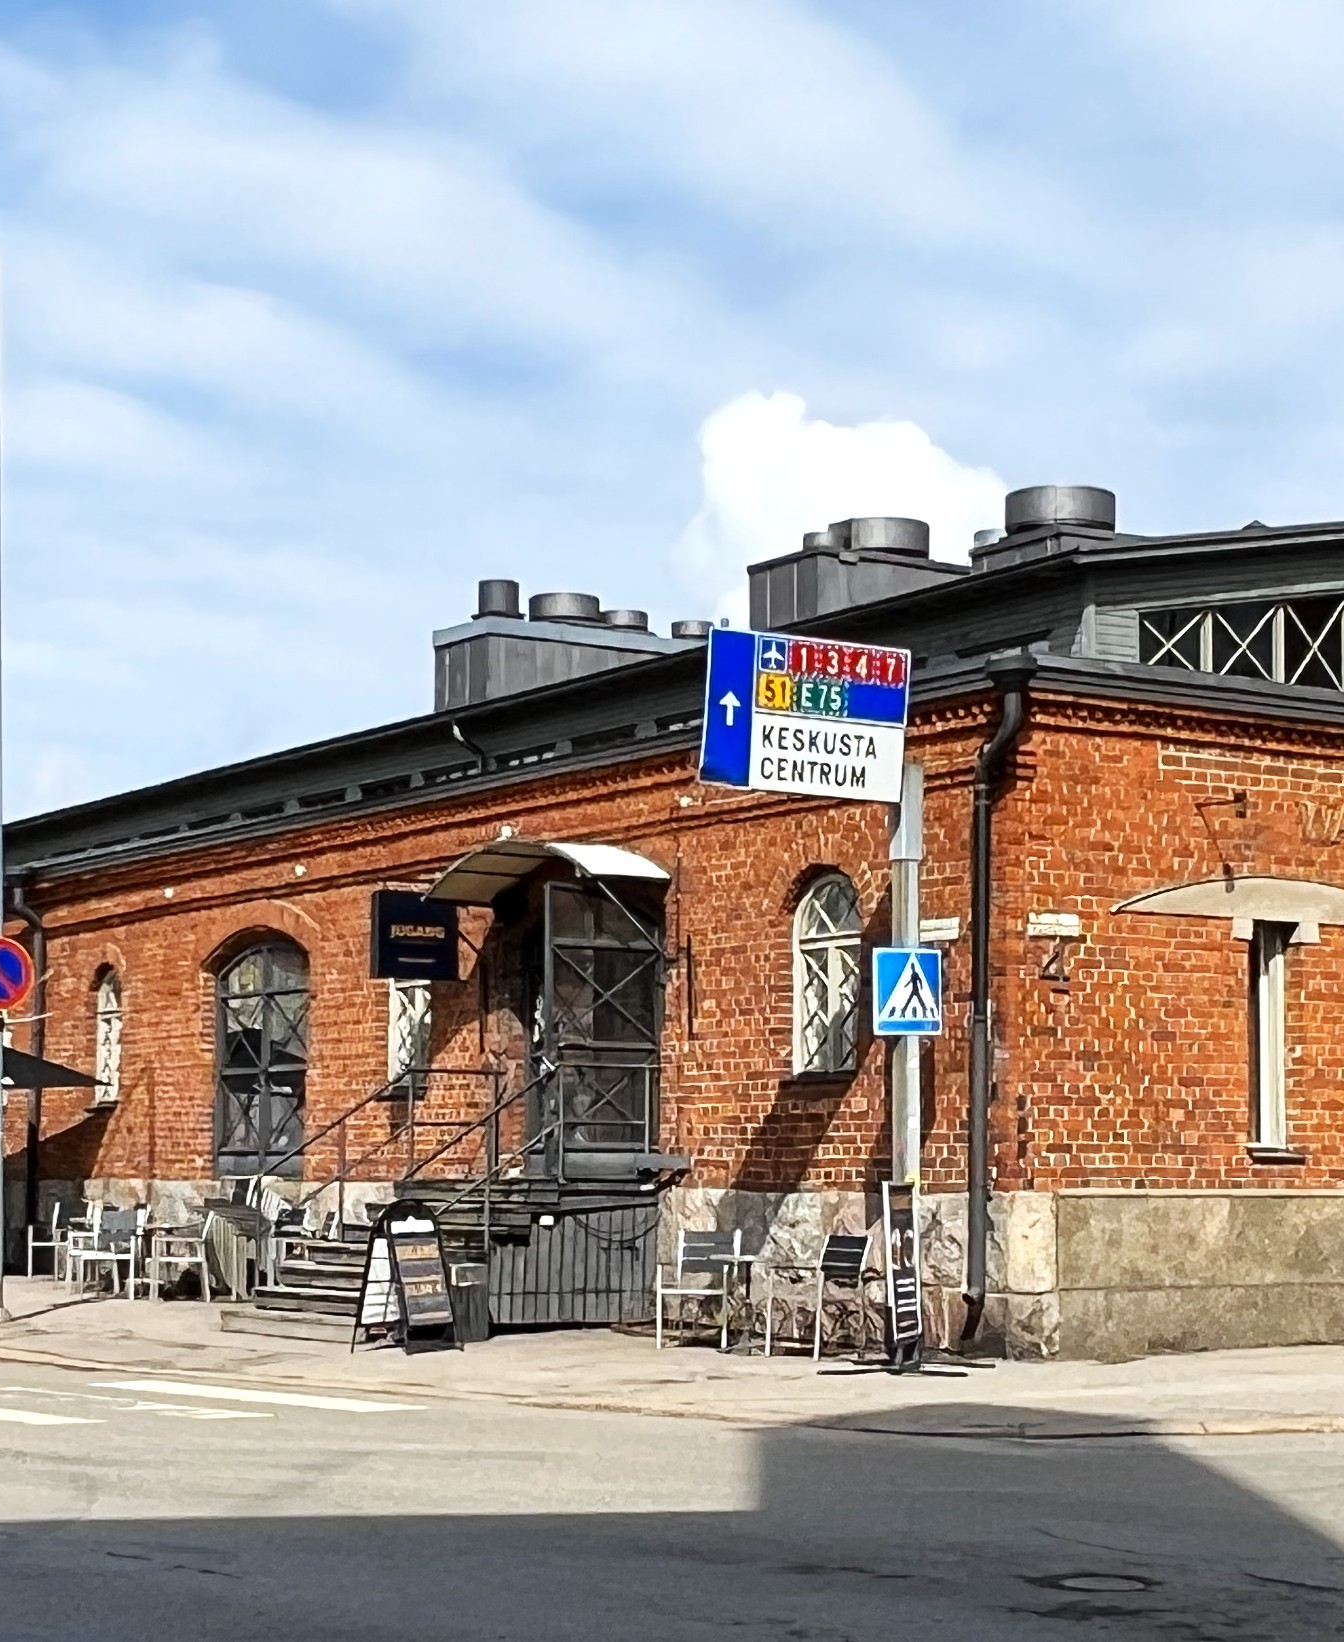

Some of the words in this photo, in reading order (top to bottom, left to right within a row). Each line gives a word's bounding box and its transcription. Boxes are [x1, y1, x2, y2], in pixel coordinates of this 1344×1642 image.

[800, 647, 808, 672] 1
[826, 650, 840, 676] 3
[855, 653, 868, 679] 4
[885, 656, 897, 683] 7
[764, 678, 788, 704] 51
[761, 724, 878, 760] KESKUSTA
[760, 756, 866, 789] CENTRUM
